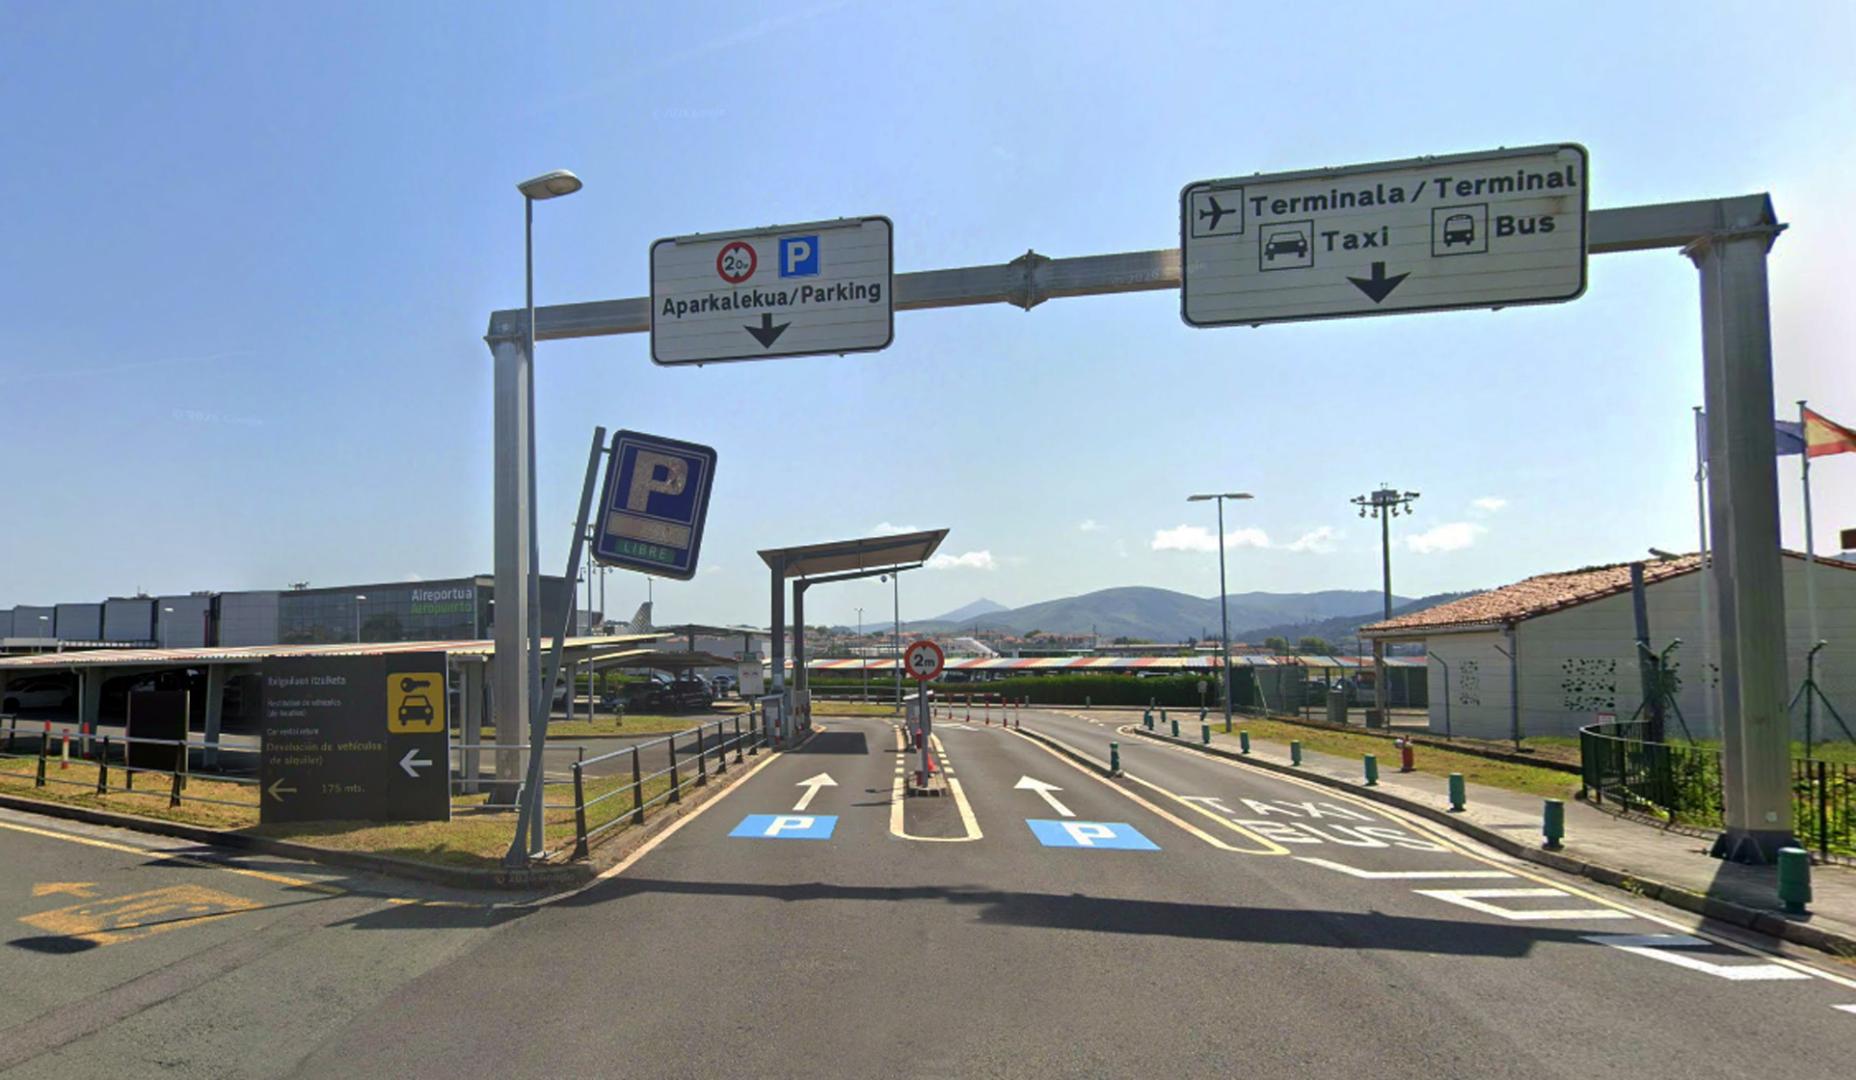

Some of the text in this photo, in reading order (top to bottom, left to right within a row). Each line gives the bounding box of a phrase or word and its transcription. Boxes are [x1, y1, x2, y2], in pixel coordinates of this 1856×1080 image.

[1250, 185, 1405, 217] Terminala
[1434, 165, 1576, 198] Terminal
[1496, 212, 1555, 238] Bus
[1322, 226, 1389, 252] Taxi
[787, 241, 811, 272] P
[626, 450, 688, 512] P
[623, 542, 668, 560] LIBRE
[411, 588, 473, 604] Aireportua
[321, 784, 342, 793] 175
[1178, 796, 1376, 822] TAXI
[763, 816, 815, 837] P
[1058, 822, 1118, 847] P
[1230, 819, 1452, 852] BUS
